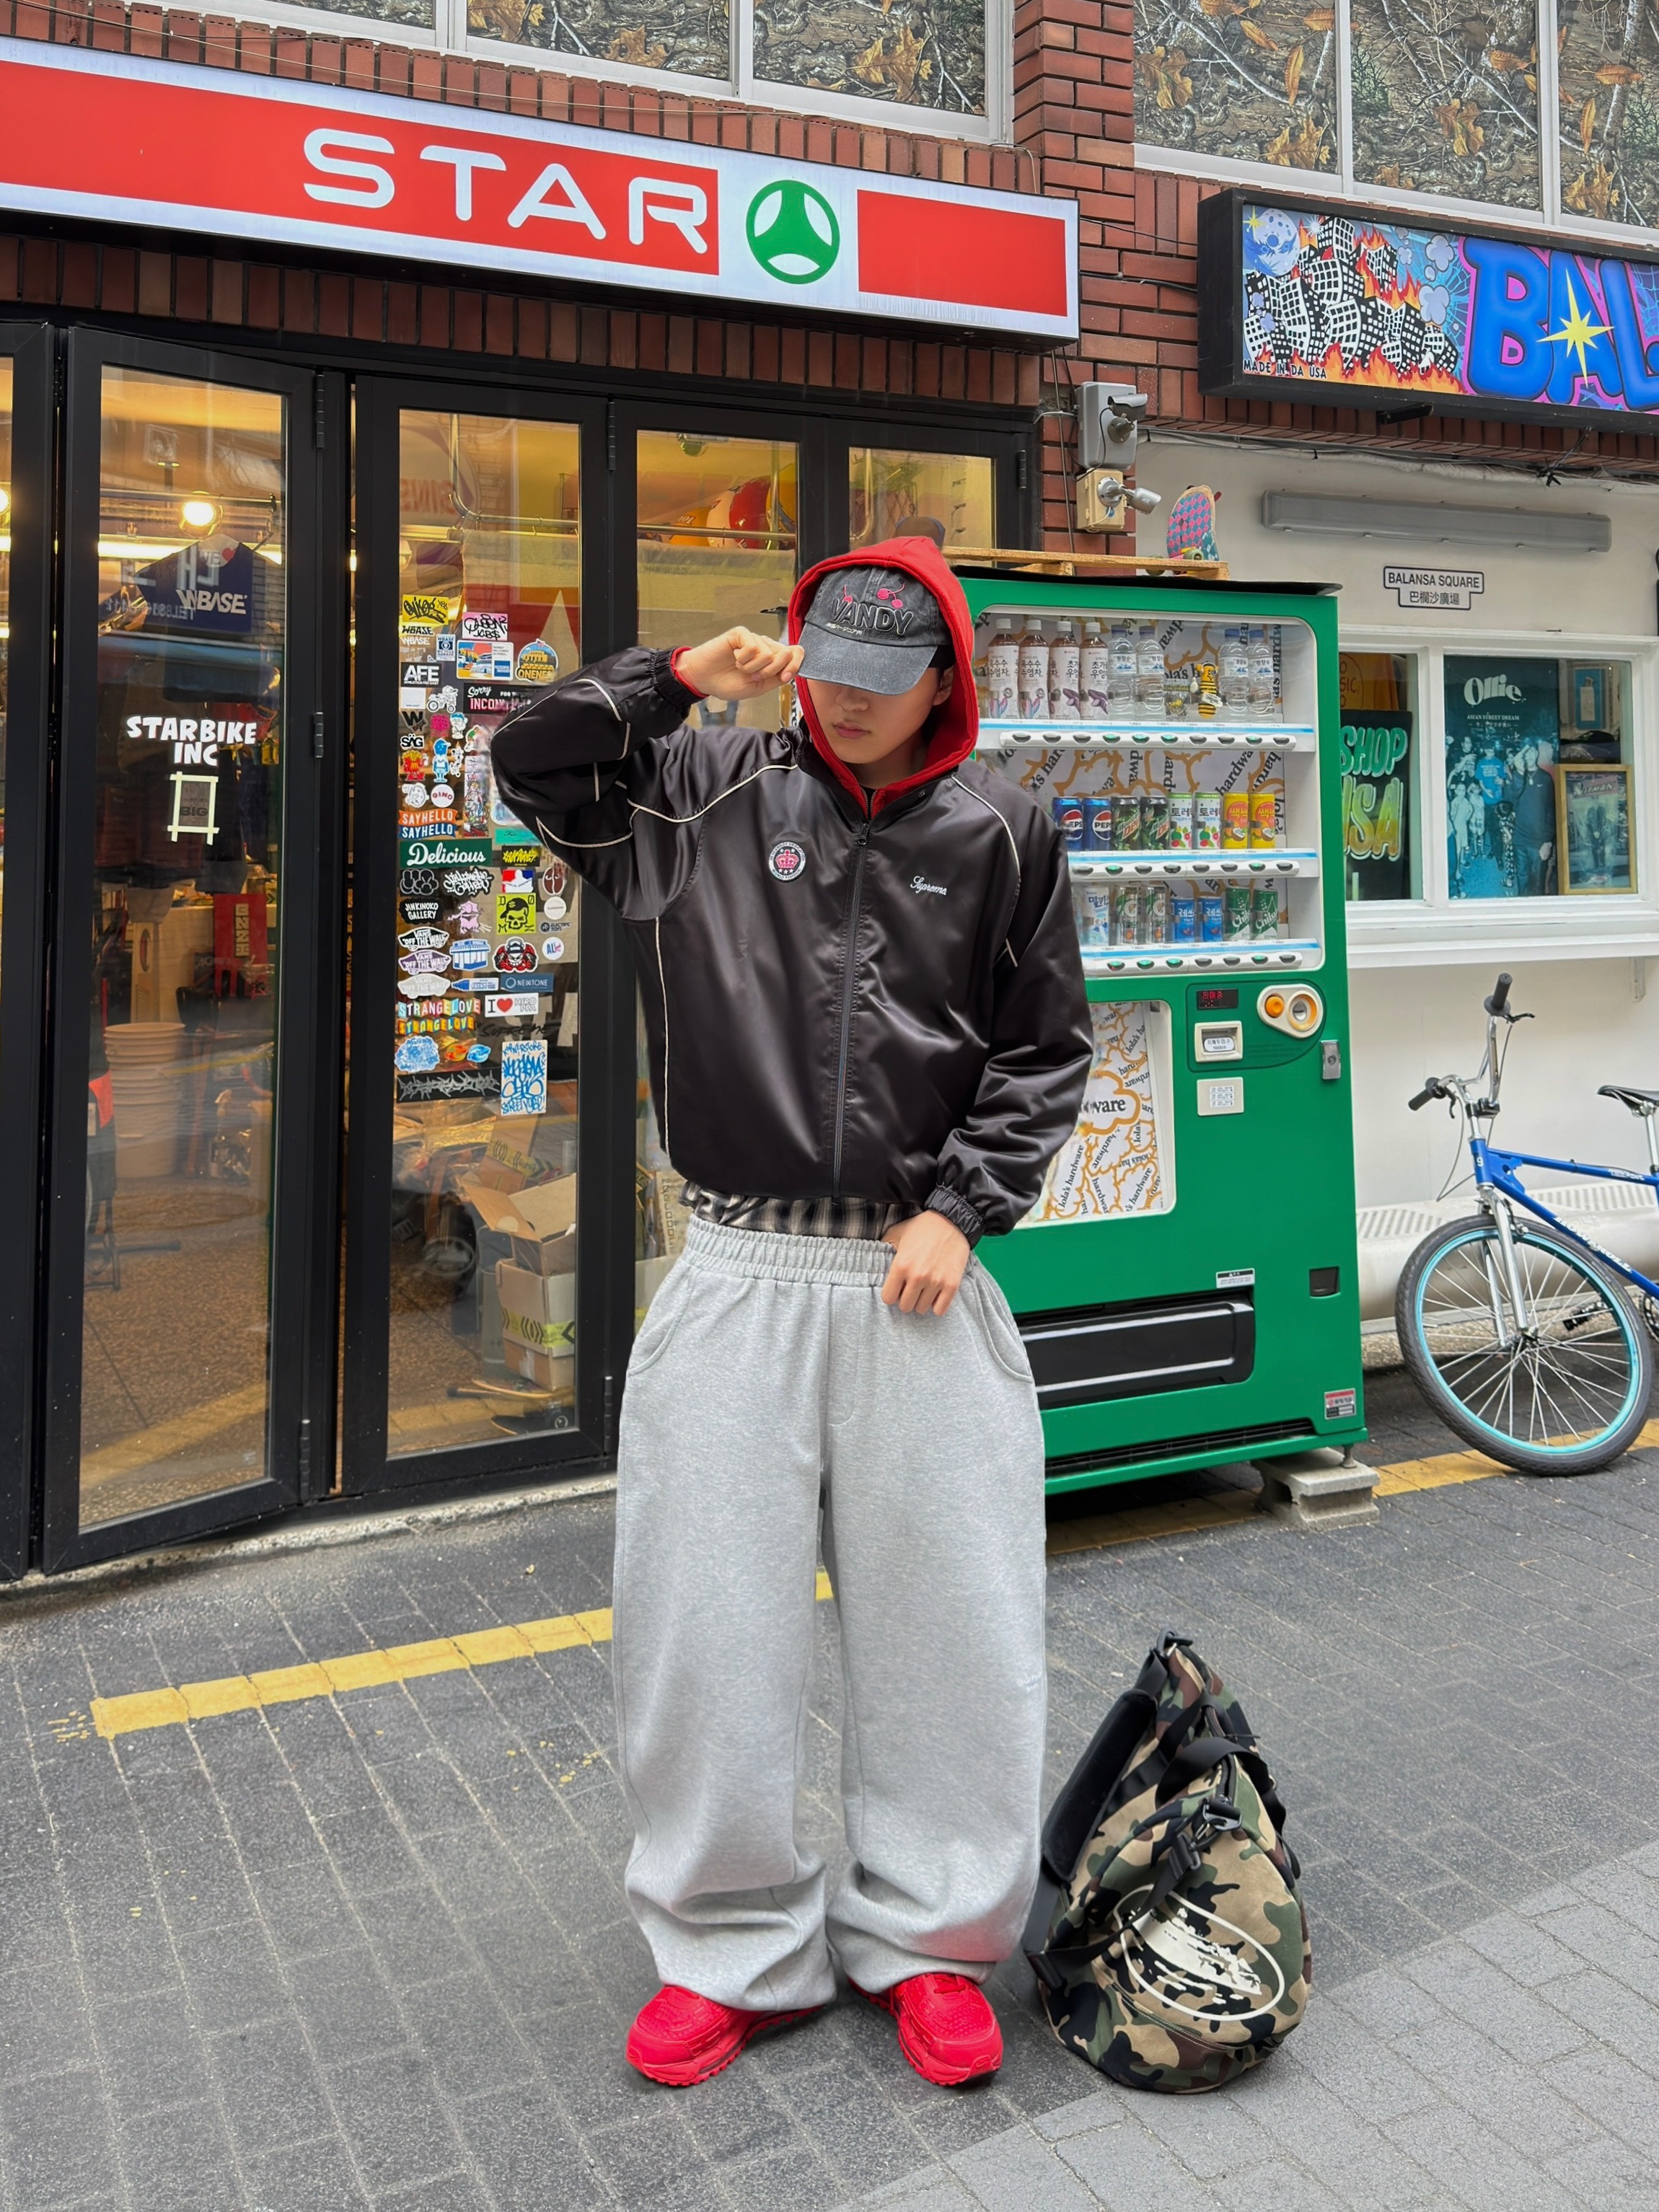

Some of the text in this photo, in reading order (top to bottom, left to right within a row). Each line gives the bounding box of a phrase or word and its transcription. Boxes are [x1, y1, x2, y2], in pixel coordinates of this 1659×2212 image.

[304, 128, 708, 255] STAR
[1461, 236, 1659, 411] BAL
[1244, 360, 1326, 379] MADE IN DA USA
[1389, 572, 1480, 589] BALANSA SQUARE
[176, 589, 248, 615] WBASE
[832, 597, 914, 635] VANDY
[403, 664, 440, 682] AFE
[467, 686, 492, 698] Sorry
[1464, 674, 1523, 706] Ollie
[126, 715, 258, 746] STARBIKE
[174, 742, 219, 767] INC
[1340, 726, 1408, 777] SHOP
[180, 806, 208, 816] BIG
[402, 810, 453, 826] SAYHELLO
[1171, 807, 1192, 817] 토레
[1200, 807, 1220, 817] 토레
[402, 823, 453, 839] SAYHELLO
[406, 842, 487, 866] Delicious
[405, 902, 439, 912] JINKINOKO
[1178, 907, 1194, 917] 레쓰
[1206, 907, 1222, 917] 레쓰
[408, 910, 436, 921] GALLERY
[413, 928, 432, 938] VANS
[418, 937, 430, 946] THE
[414, 952, 434, 961] VANS
[418, 960, 431, 969] THE
[398, 998, 480, 1018] STRANGELOVE
[488, 999, 496, 1013] I
[398, 1016, 475, 1034] STRANGELOVE
[1067, 1144, 1085, 1186] hardware
